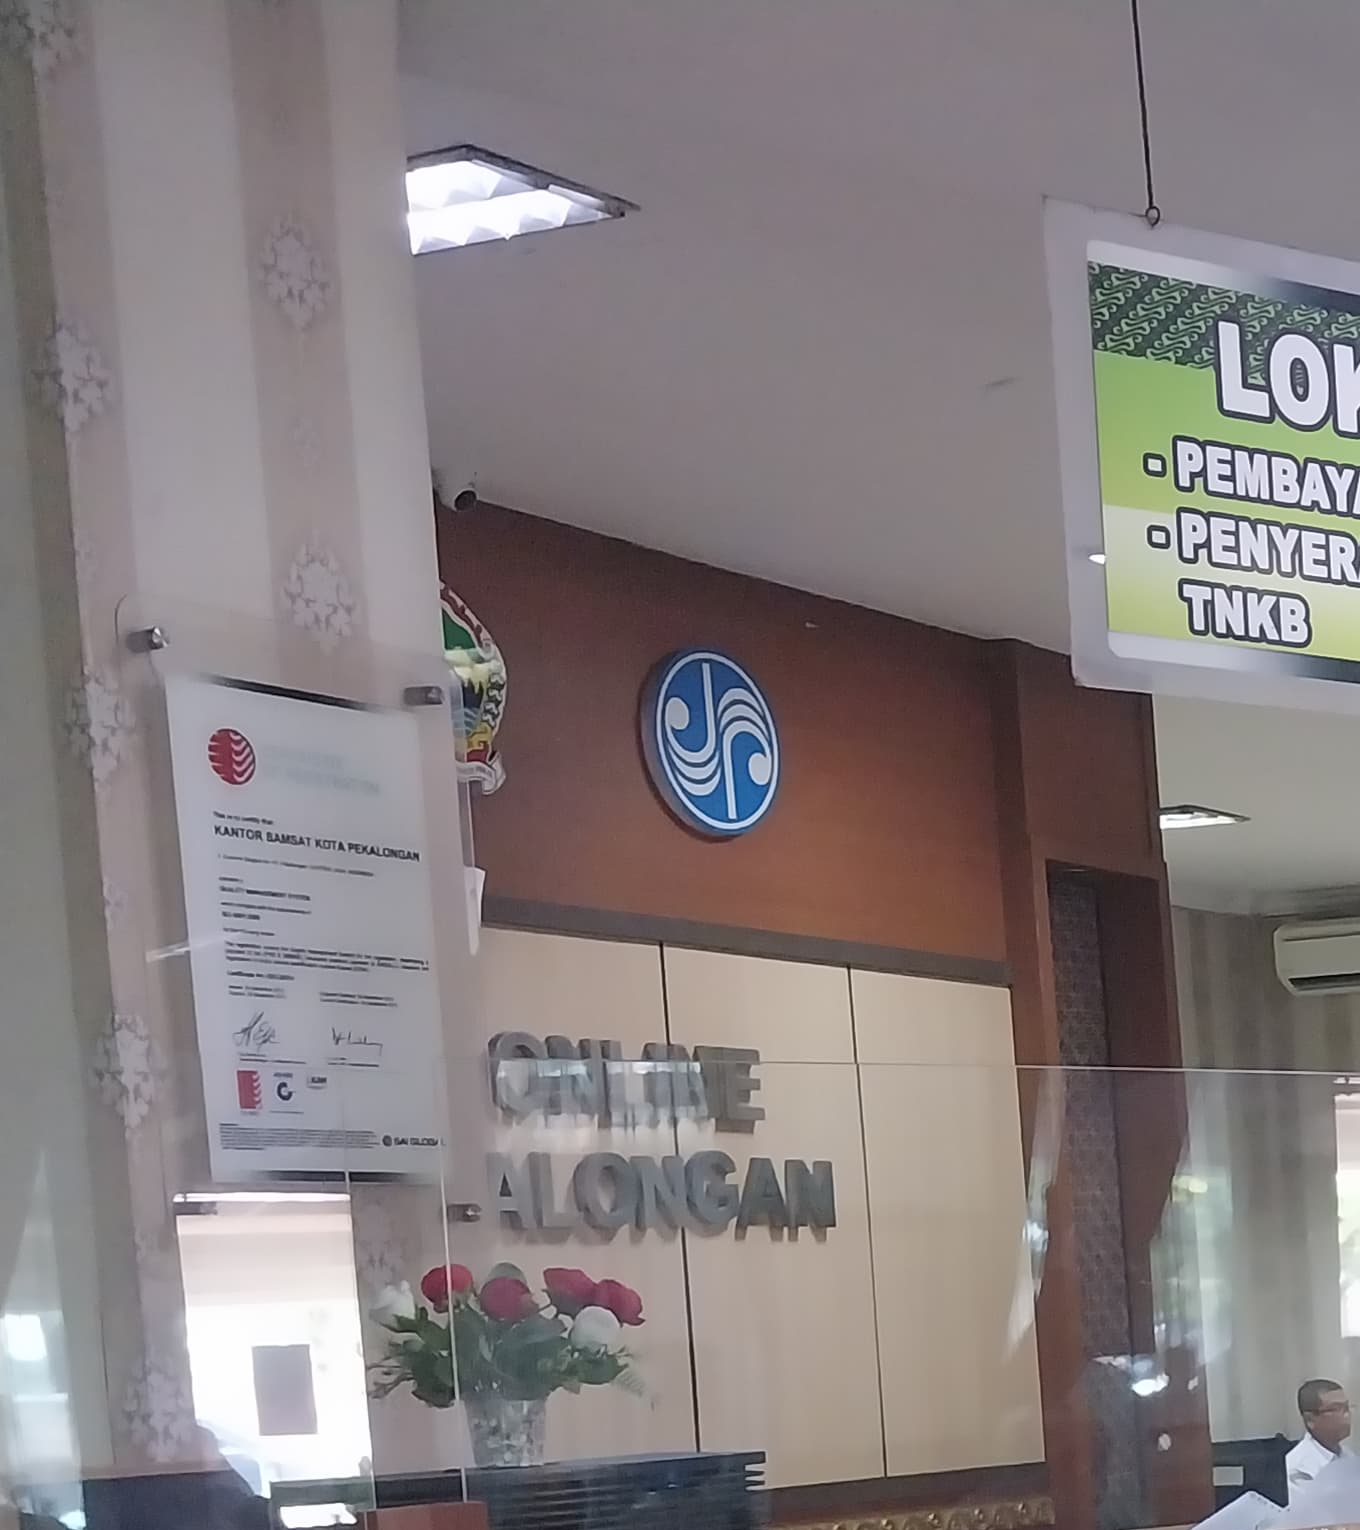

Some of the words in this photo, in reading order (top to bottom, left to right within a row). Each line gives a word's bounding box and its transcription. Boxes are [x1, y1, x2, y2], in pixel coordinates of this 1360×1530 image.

[1179, 581, 1312, 647] TNKB
[214, 825, 263, 842] KANTOR
[266, 831, 311, 847] SAMSAT
[314, 838, 346, 853] KOTA
[347, 842, 420, 862] PEKALONGAN
